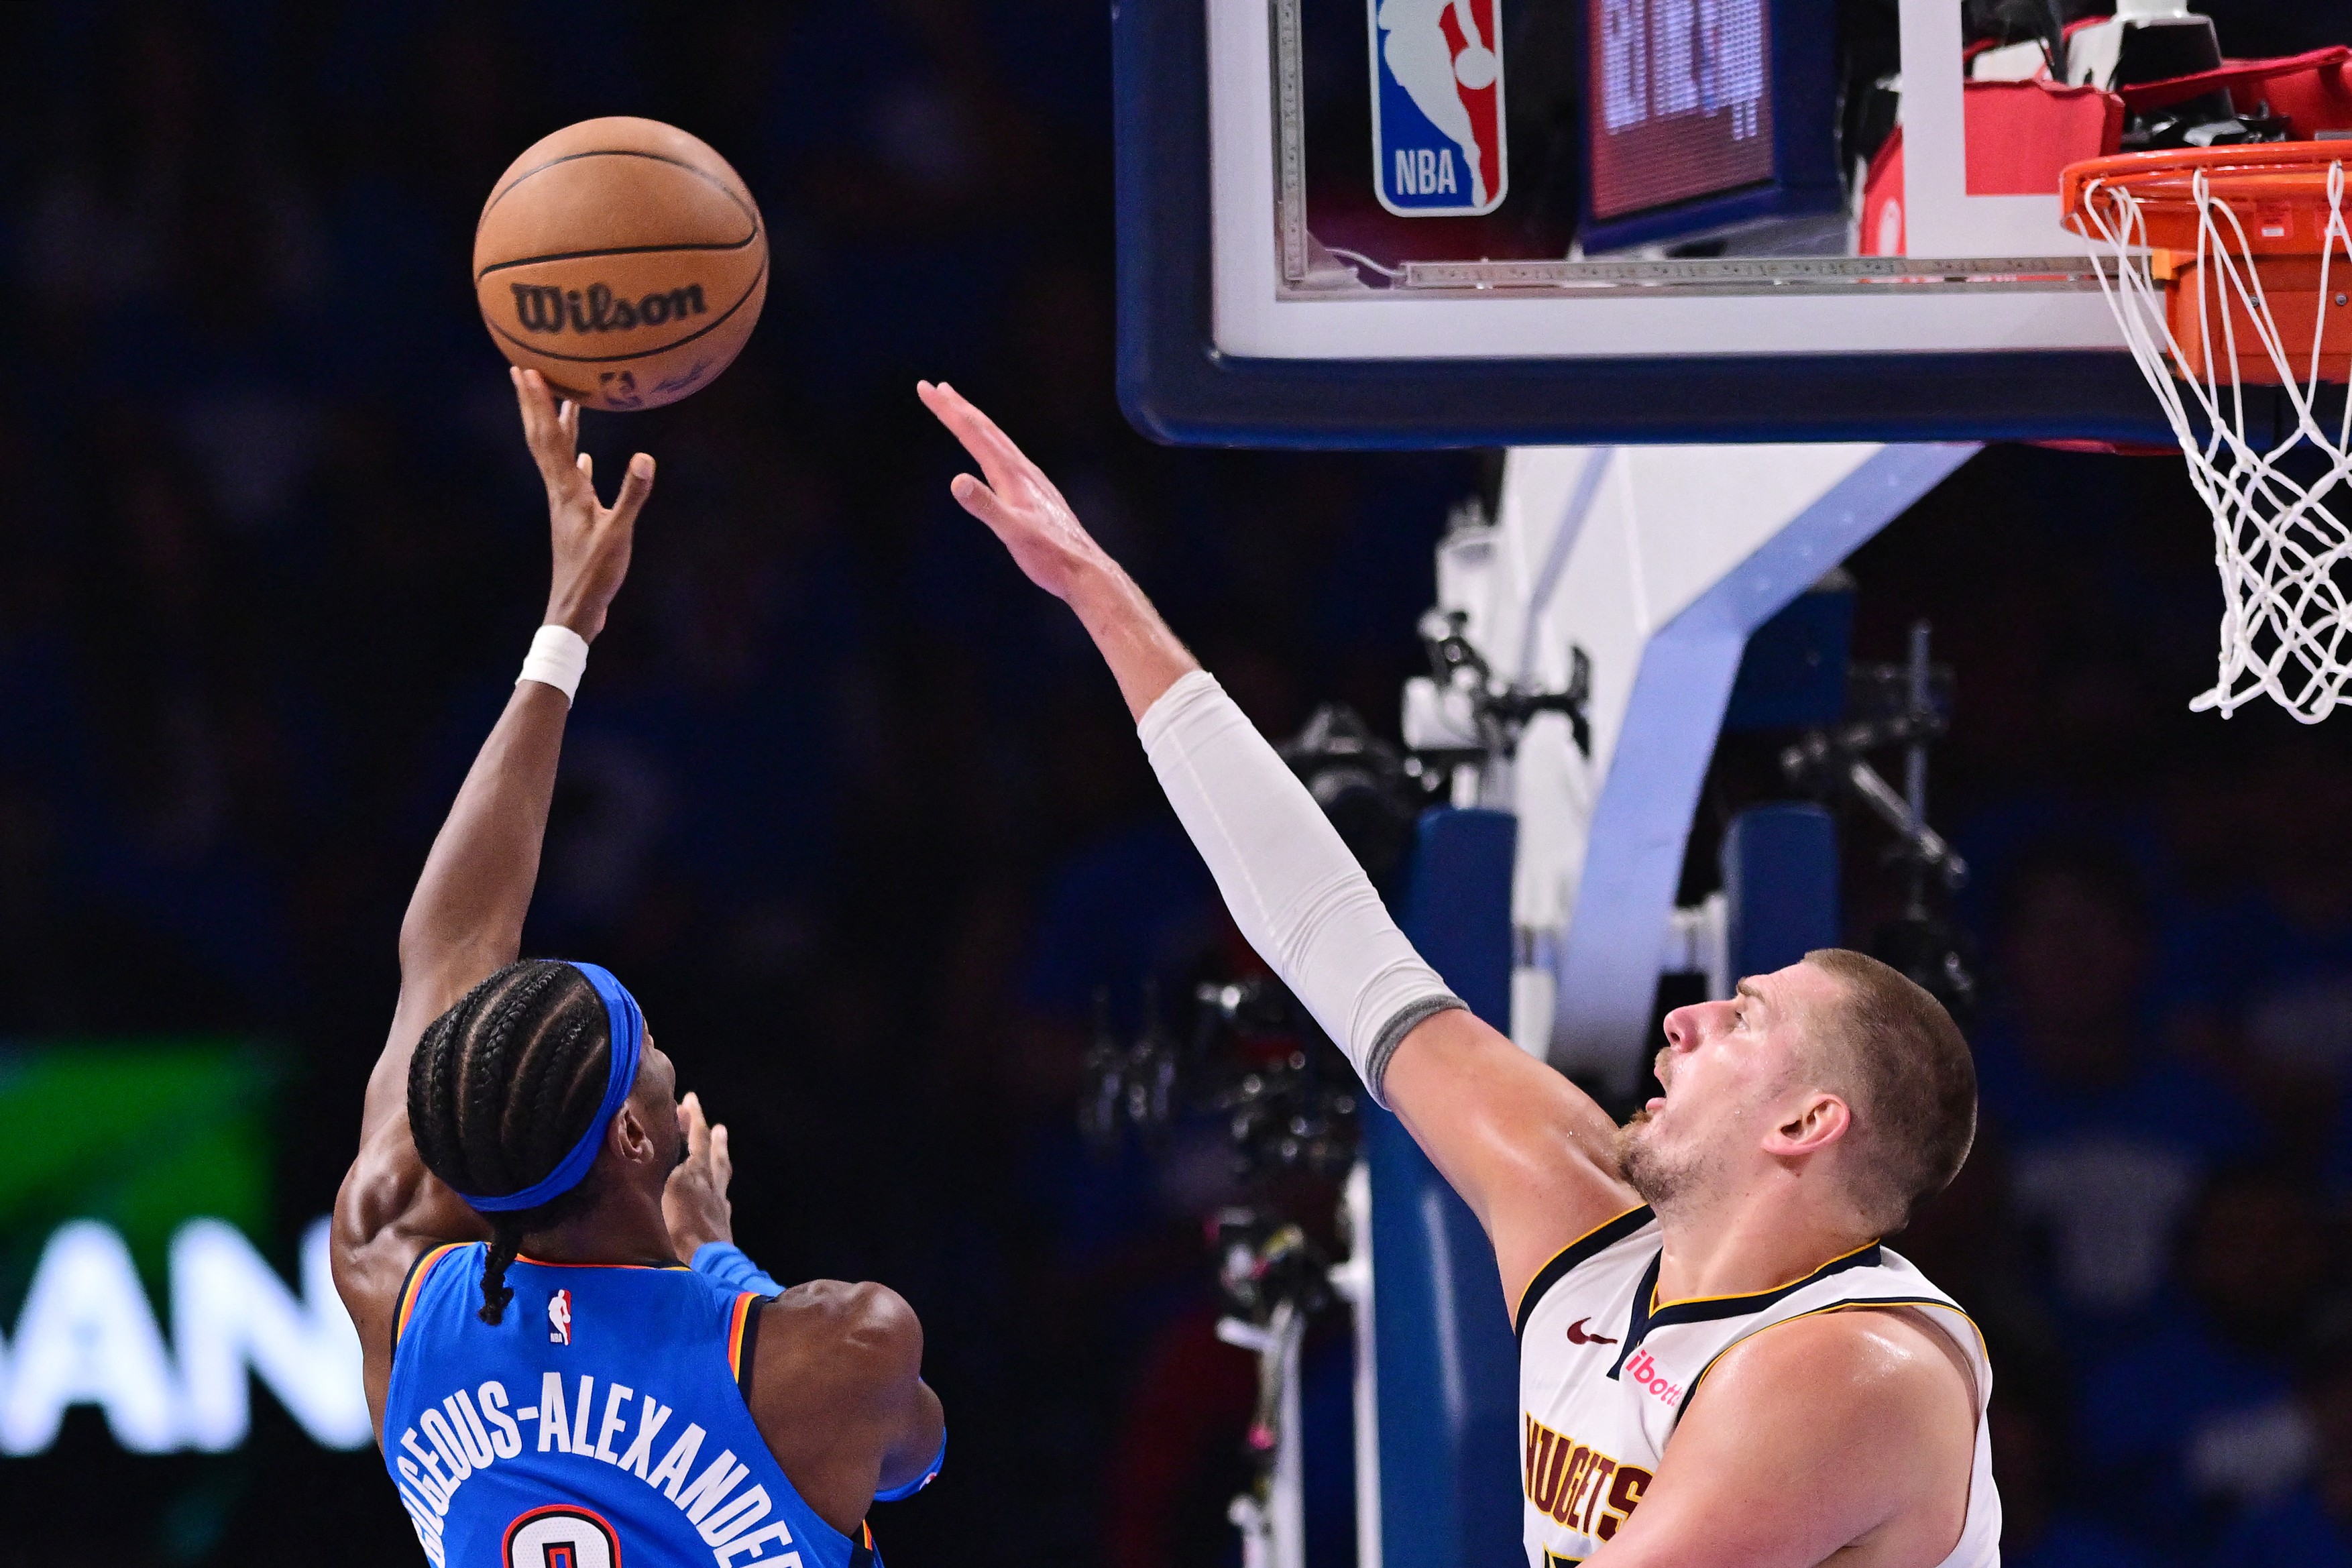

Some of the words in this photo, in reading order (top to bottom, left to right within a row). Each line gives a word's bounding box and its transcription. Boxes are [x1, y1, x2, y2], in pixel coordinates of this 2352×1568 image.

[1395, 148, 1457, 195] NBA
[510, 282, 706, 333] Wilson
[0, 1217, 379, 1455] AN
